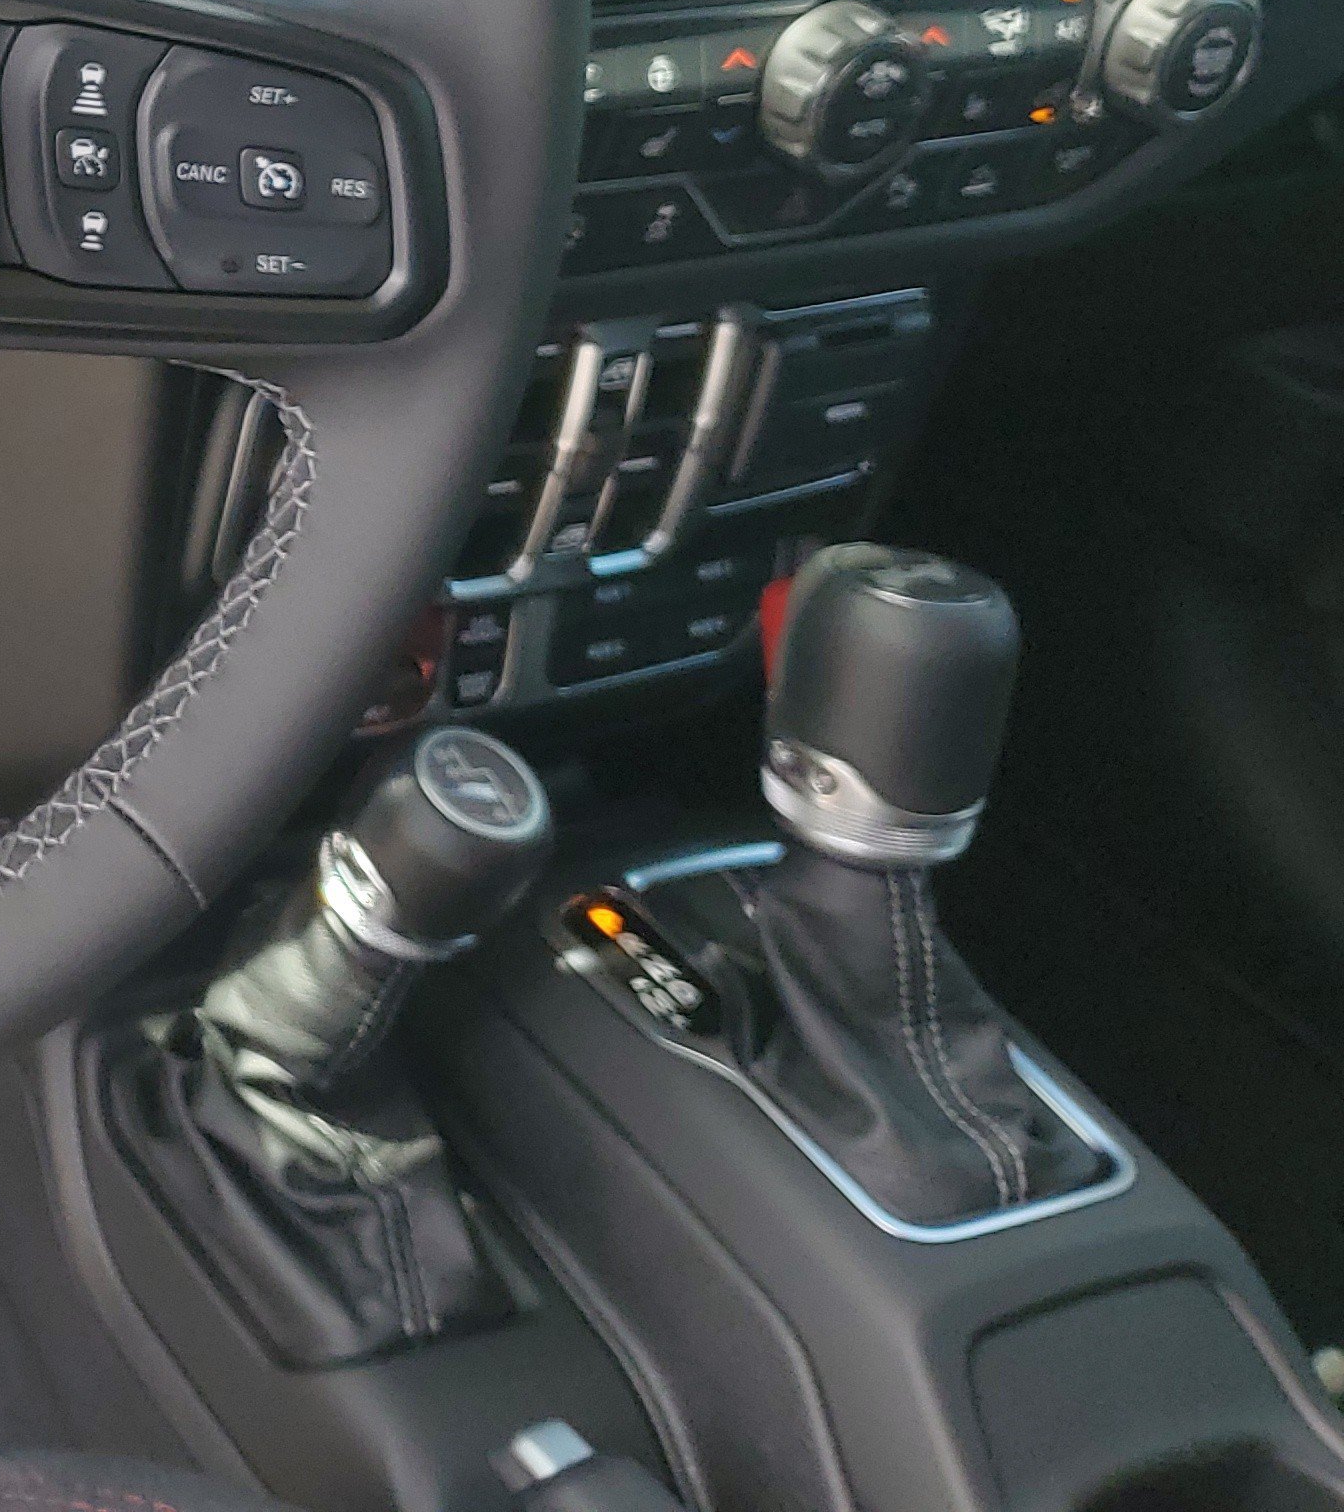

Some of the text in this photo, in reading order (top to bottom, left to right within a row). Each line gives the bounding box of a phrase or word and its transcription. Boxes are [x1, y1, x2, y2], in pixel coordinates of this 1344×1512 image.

[249, 85, 299, 107] SET+
[176, 162, 229, 184] CANC
[330, 178, 367, 199] RES
